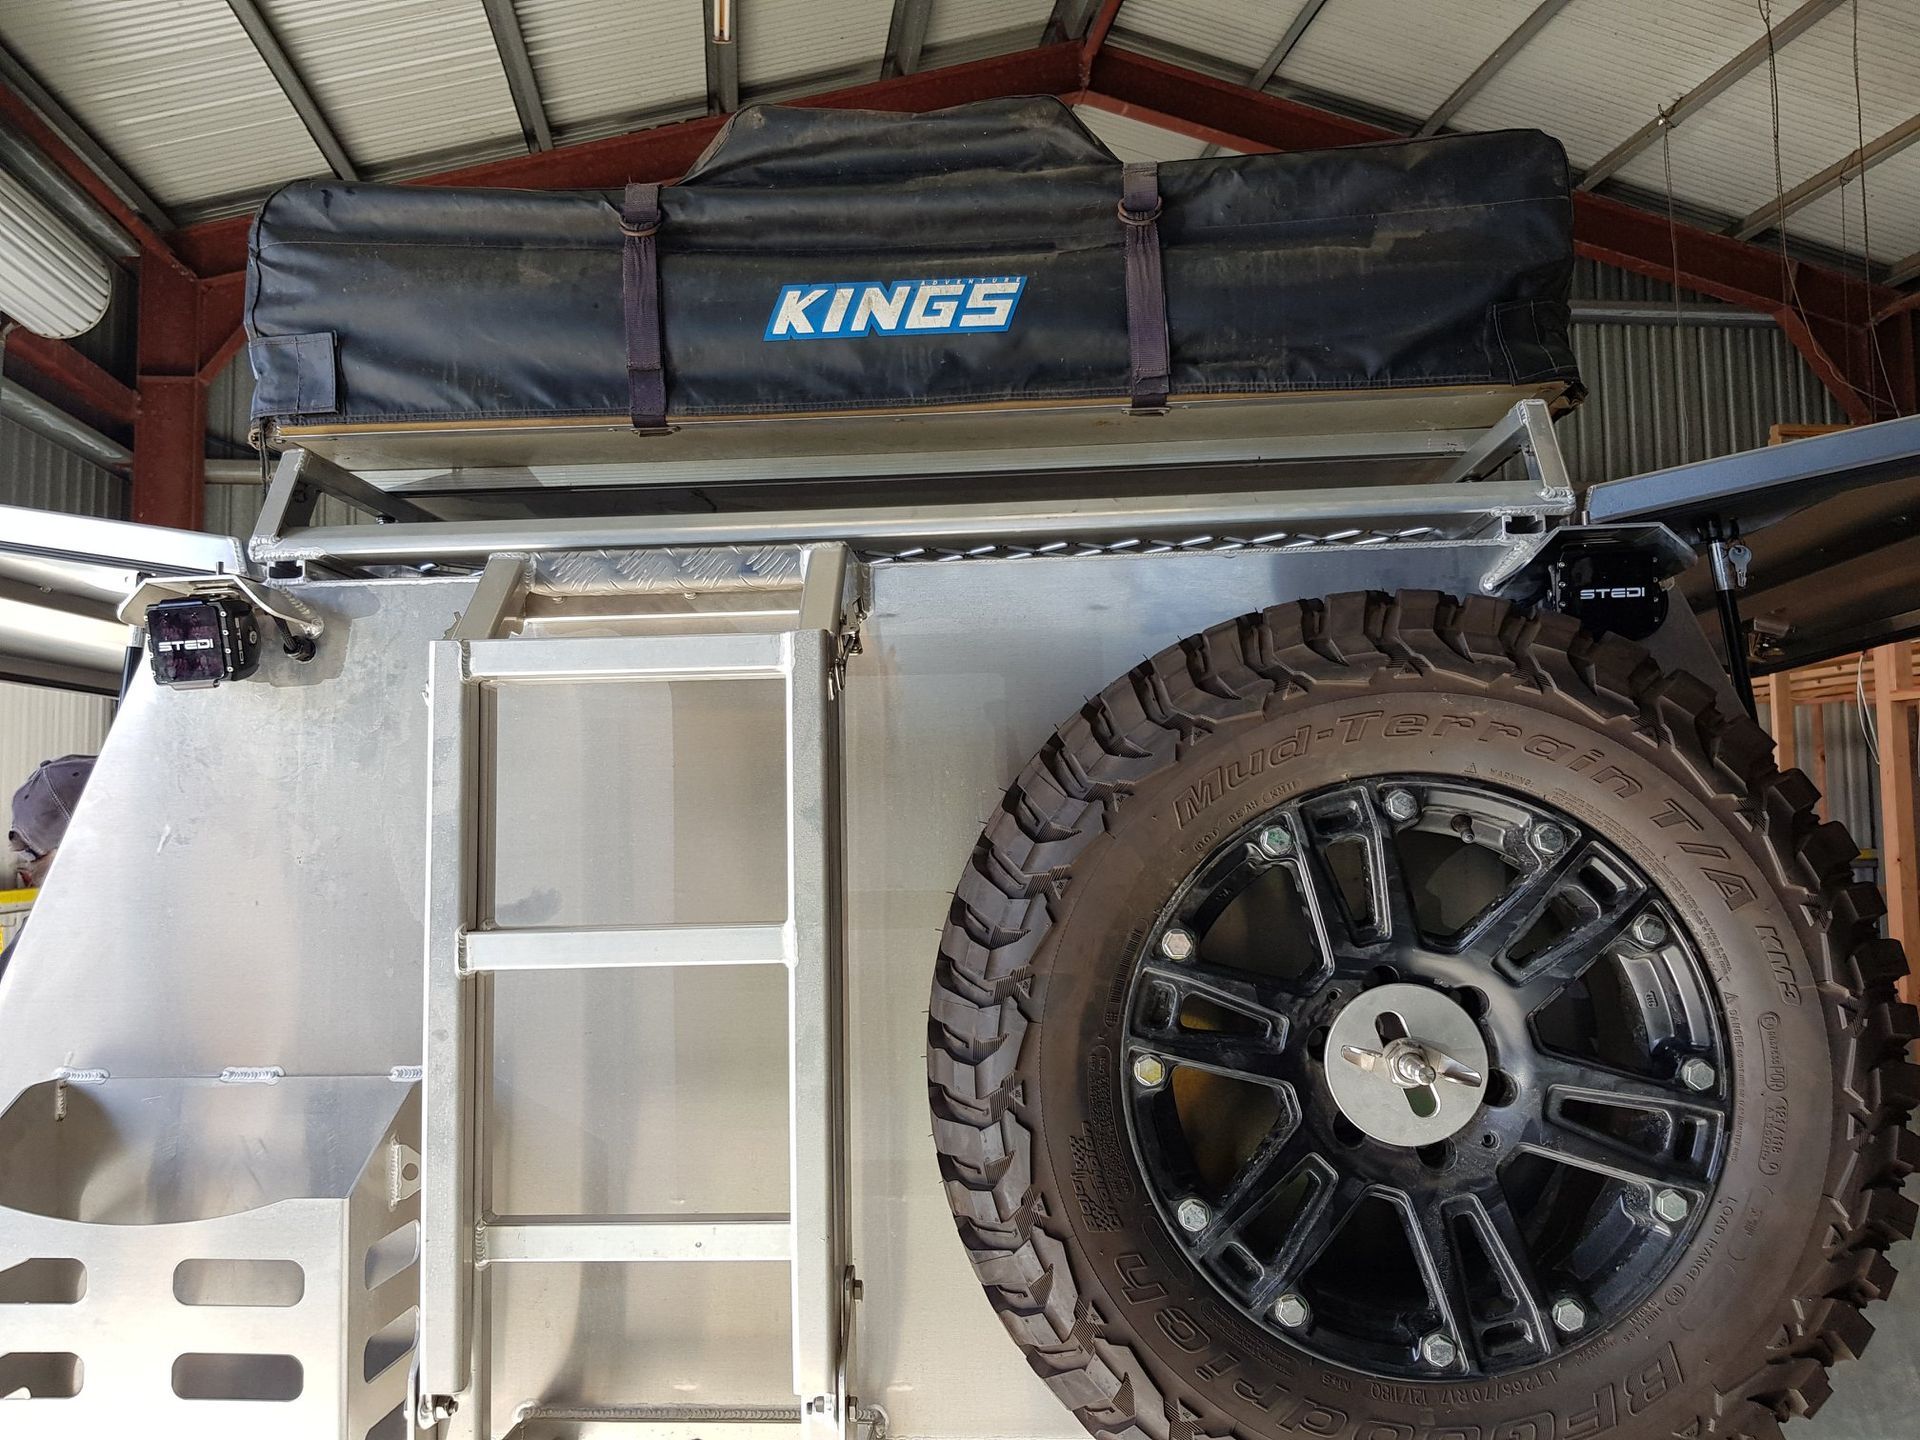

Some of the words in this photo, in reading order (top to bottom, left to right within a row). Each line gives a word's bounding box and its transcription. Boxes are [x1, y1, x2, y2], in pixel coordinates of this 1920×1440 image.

[920, 276, 1022, 286] ADVENTURE
[772, 283, 1020, 334] KINGS
[1580, 587, 1645, 600] STEDI
[159, 638, 214, 652] STEDI
[1172, 709, 1643, 831] Mud-Terrain
[1650, 798, 1759, 912] T/A
